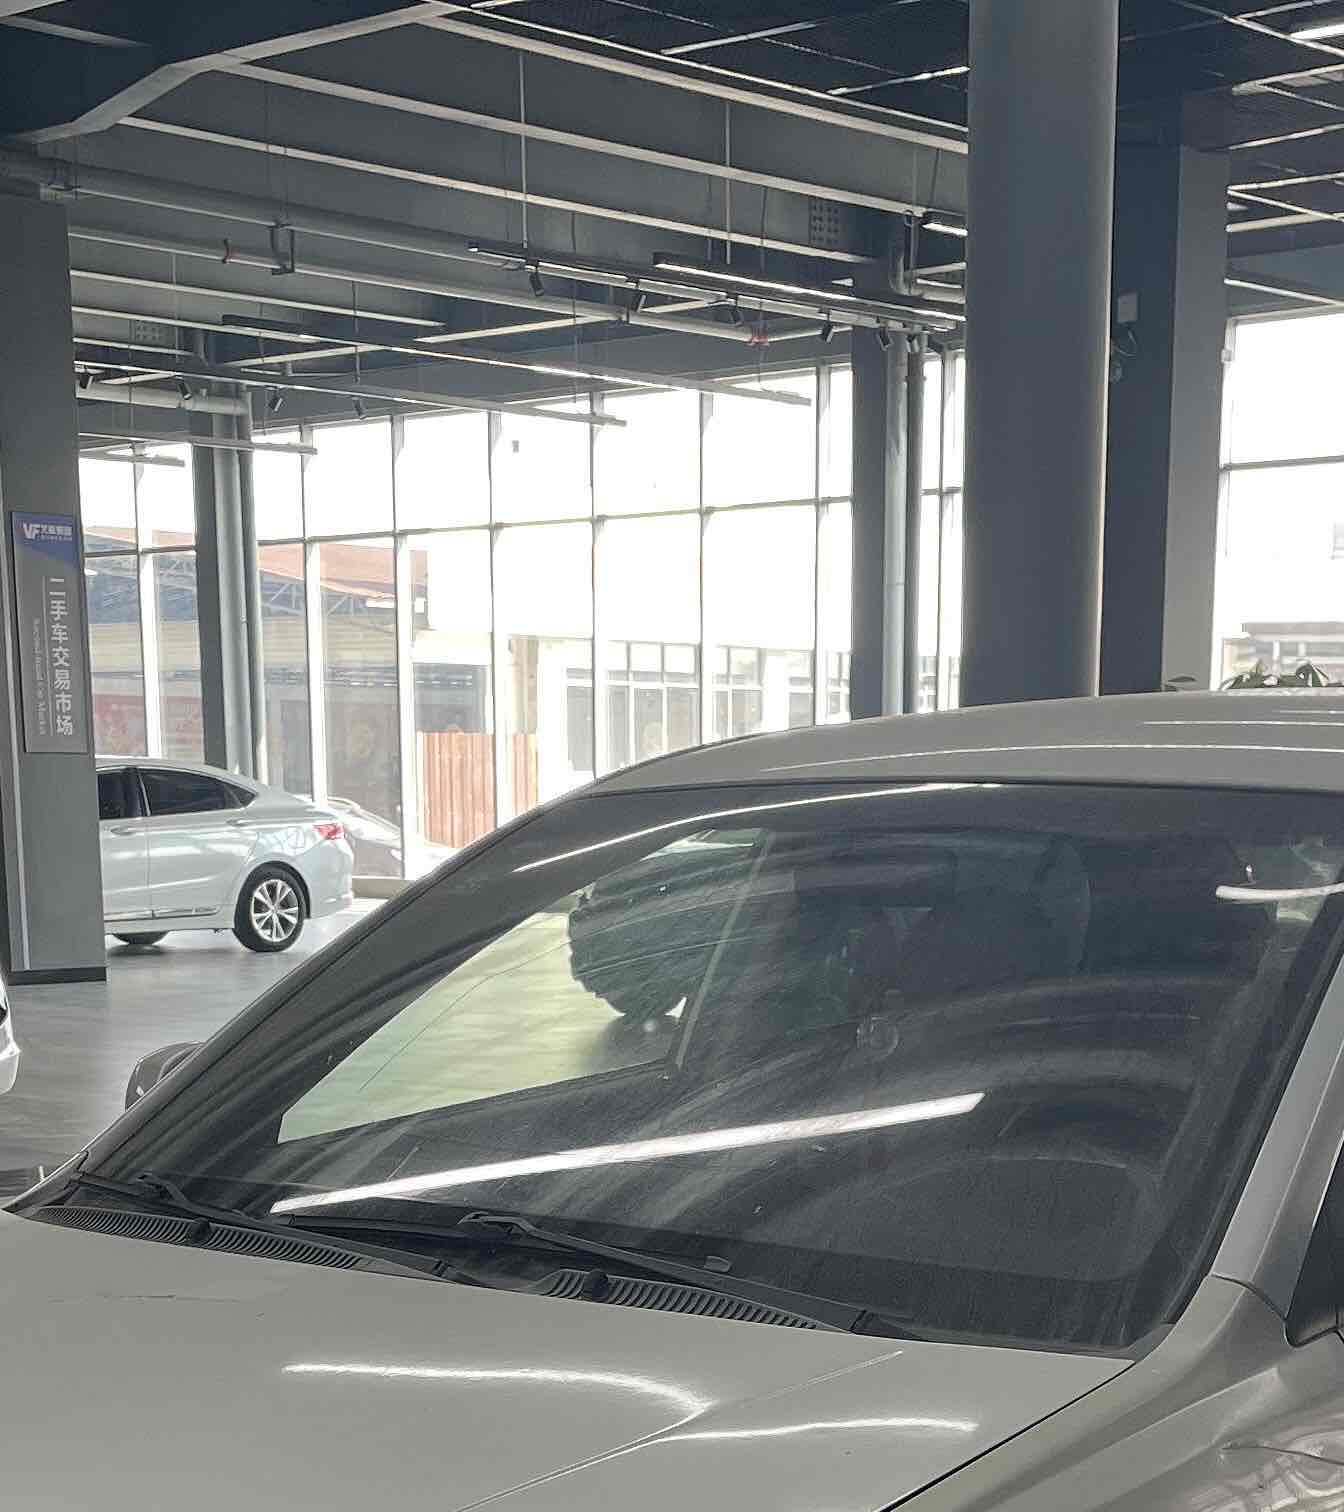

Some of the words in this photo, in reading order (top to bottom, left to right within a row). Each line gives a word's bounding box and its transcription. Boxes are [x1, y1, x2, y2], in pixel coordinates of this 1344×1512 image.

[49, 577, 73, 735] 二手车交易市场
